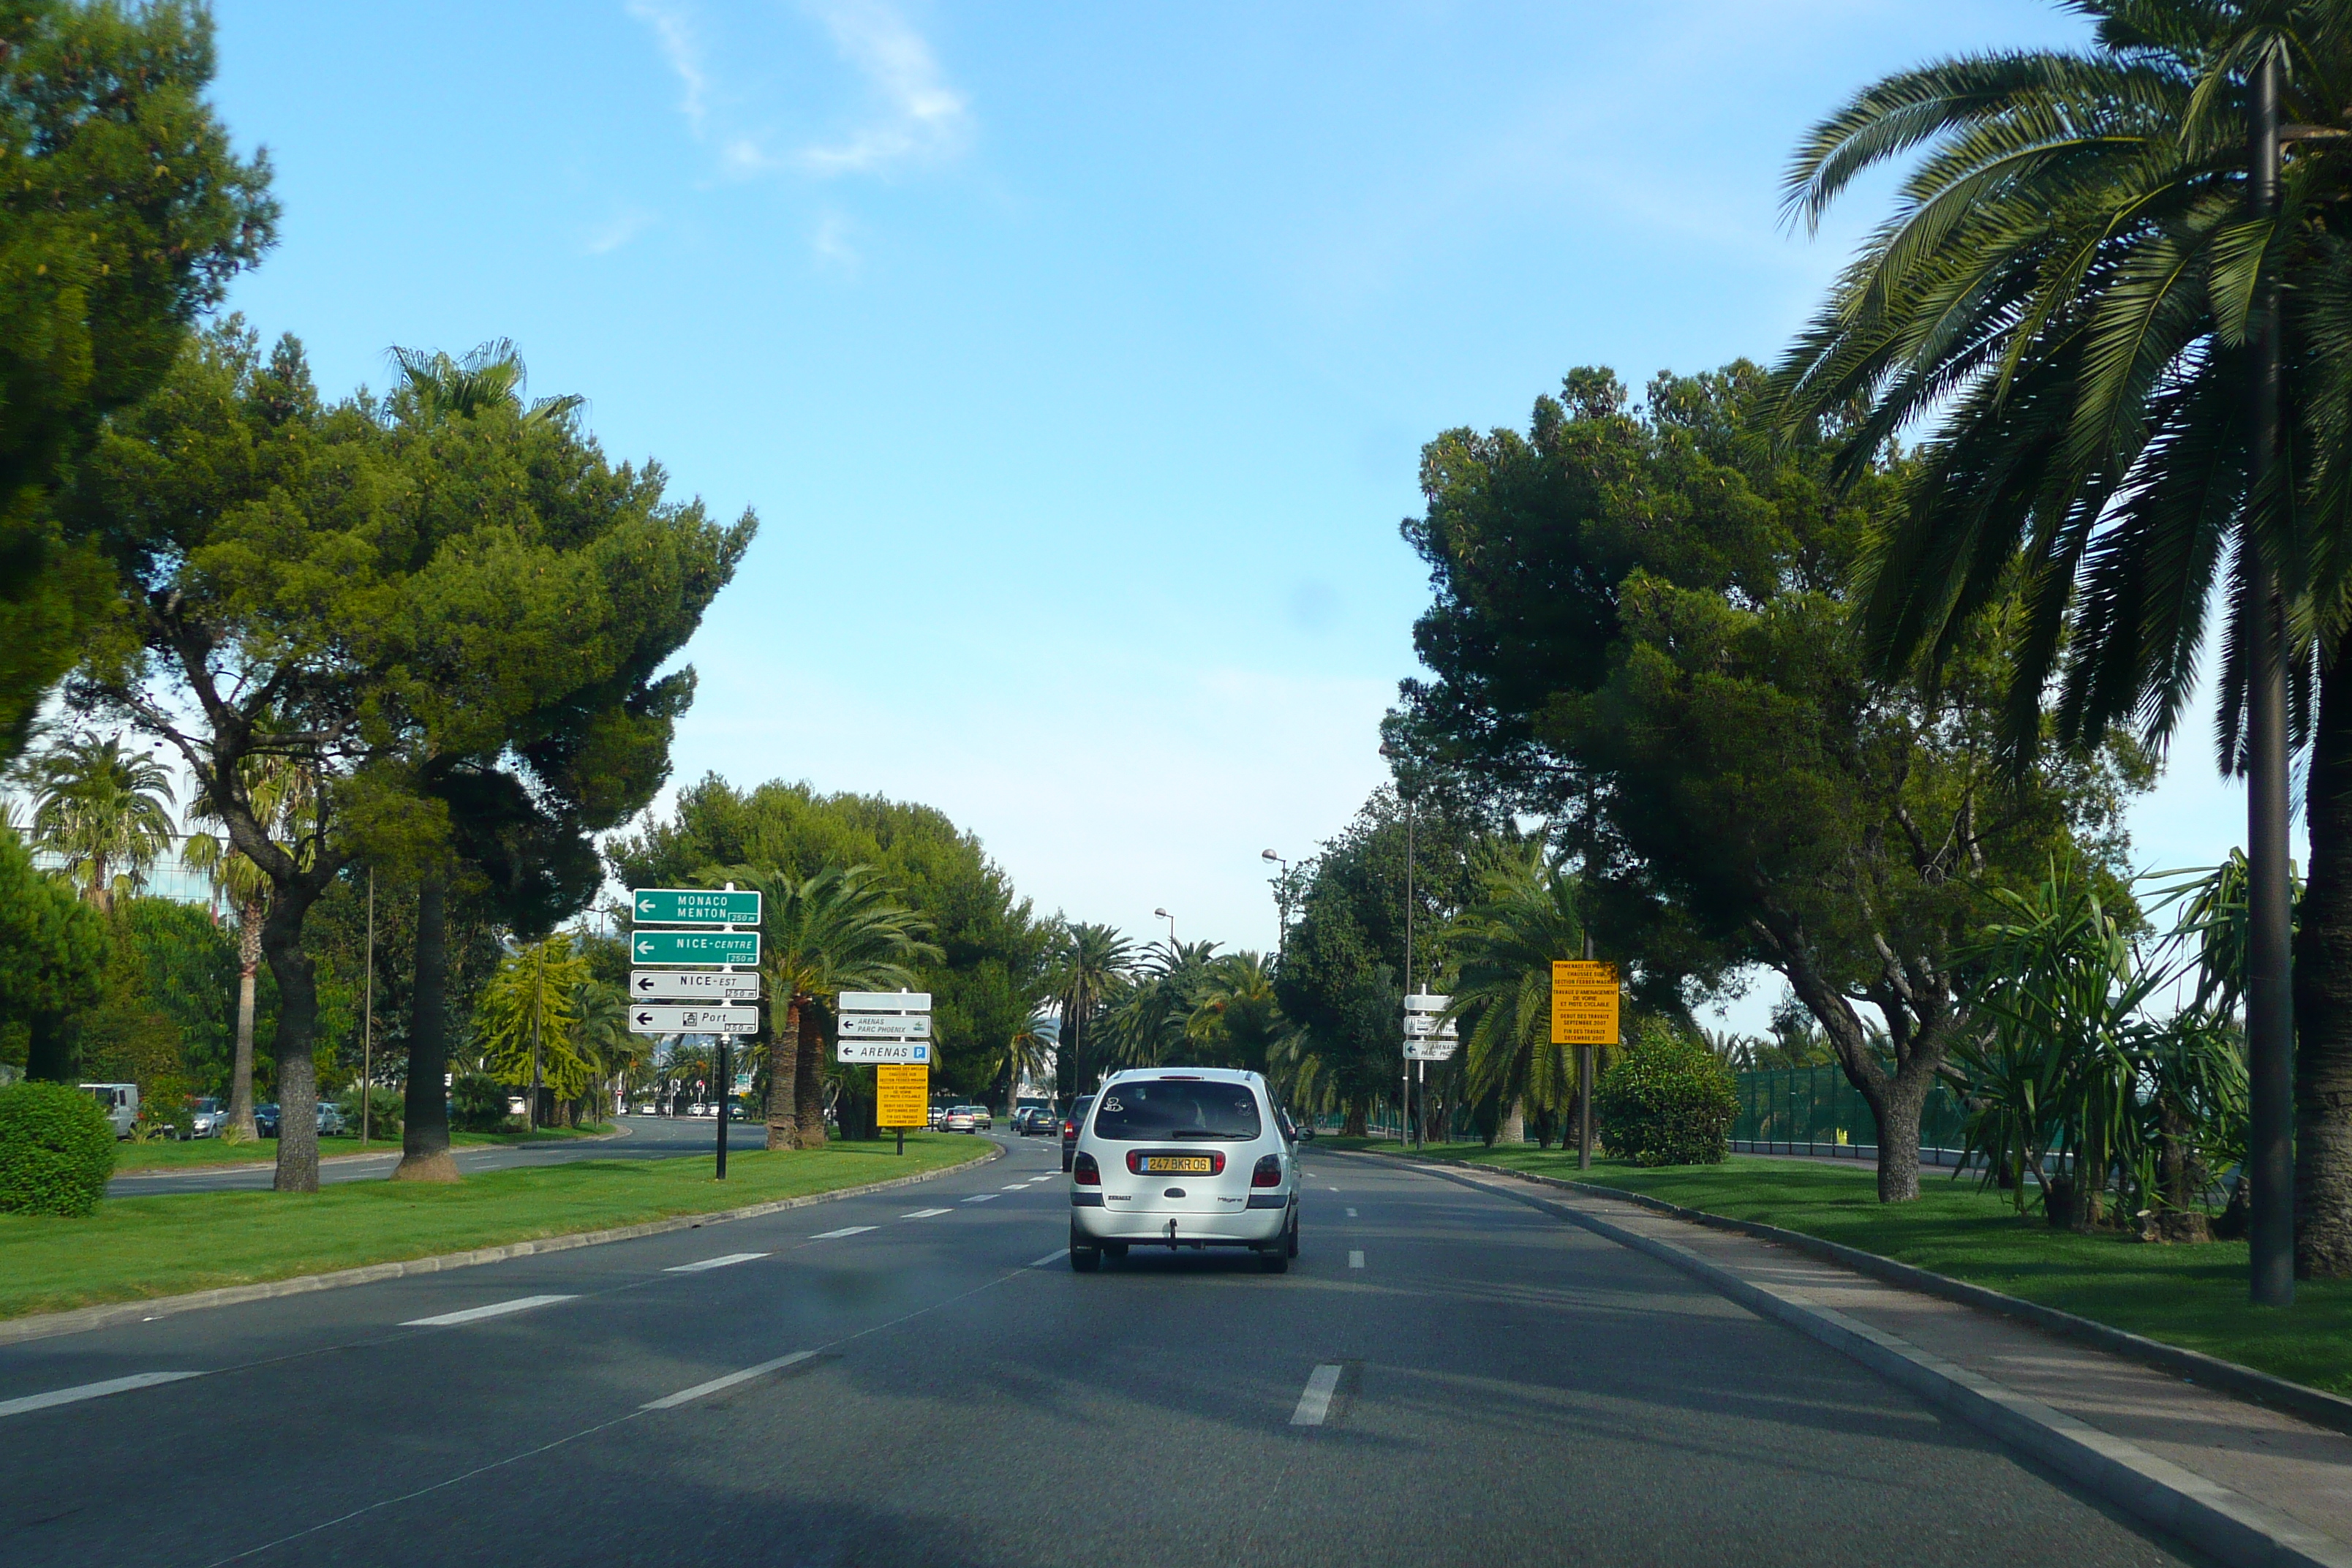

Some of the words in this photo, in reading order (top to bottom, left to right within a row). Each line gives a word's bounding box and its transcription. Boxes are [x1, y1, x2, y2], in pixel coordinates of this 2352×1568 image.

[678, 896, 727, 905] MONACO
[677, 908, 726, 918] MENTON
[676, 939, 752, 949] NICE-CENTRE
[680, 976, 736, 986] NICE-EST
[702, 1013, 726, 1022] Port
[861, 1047, 908, 1057] ARENAS
[1150, 1158, 1170, 1169] 247
[1172, 1159, 1191, 1170] BKR
[1194, 1159, 1207, 1170] 06
